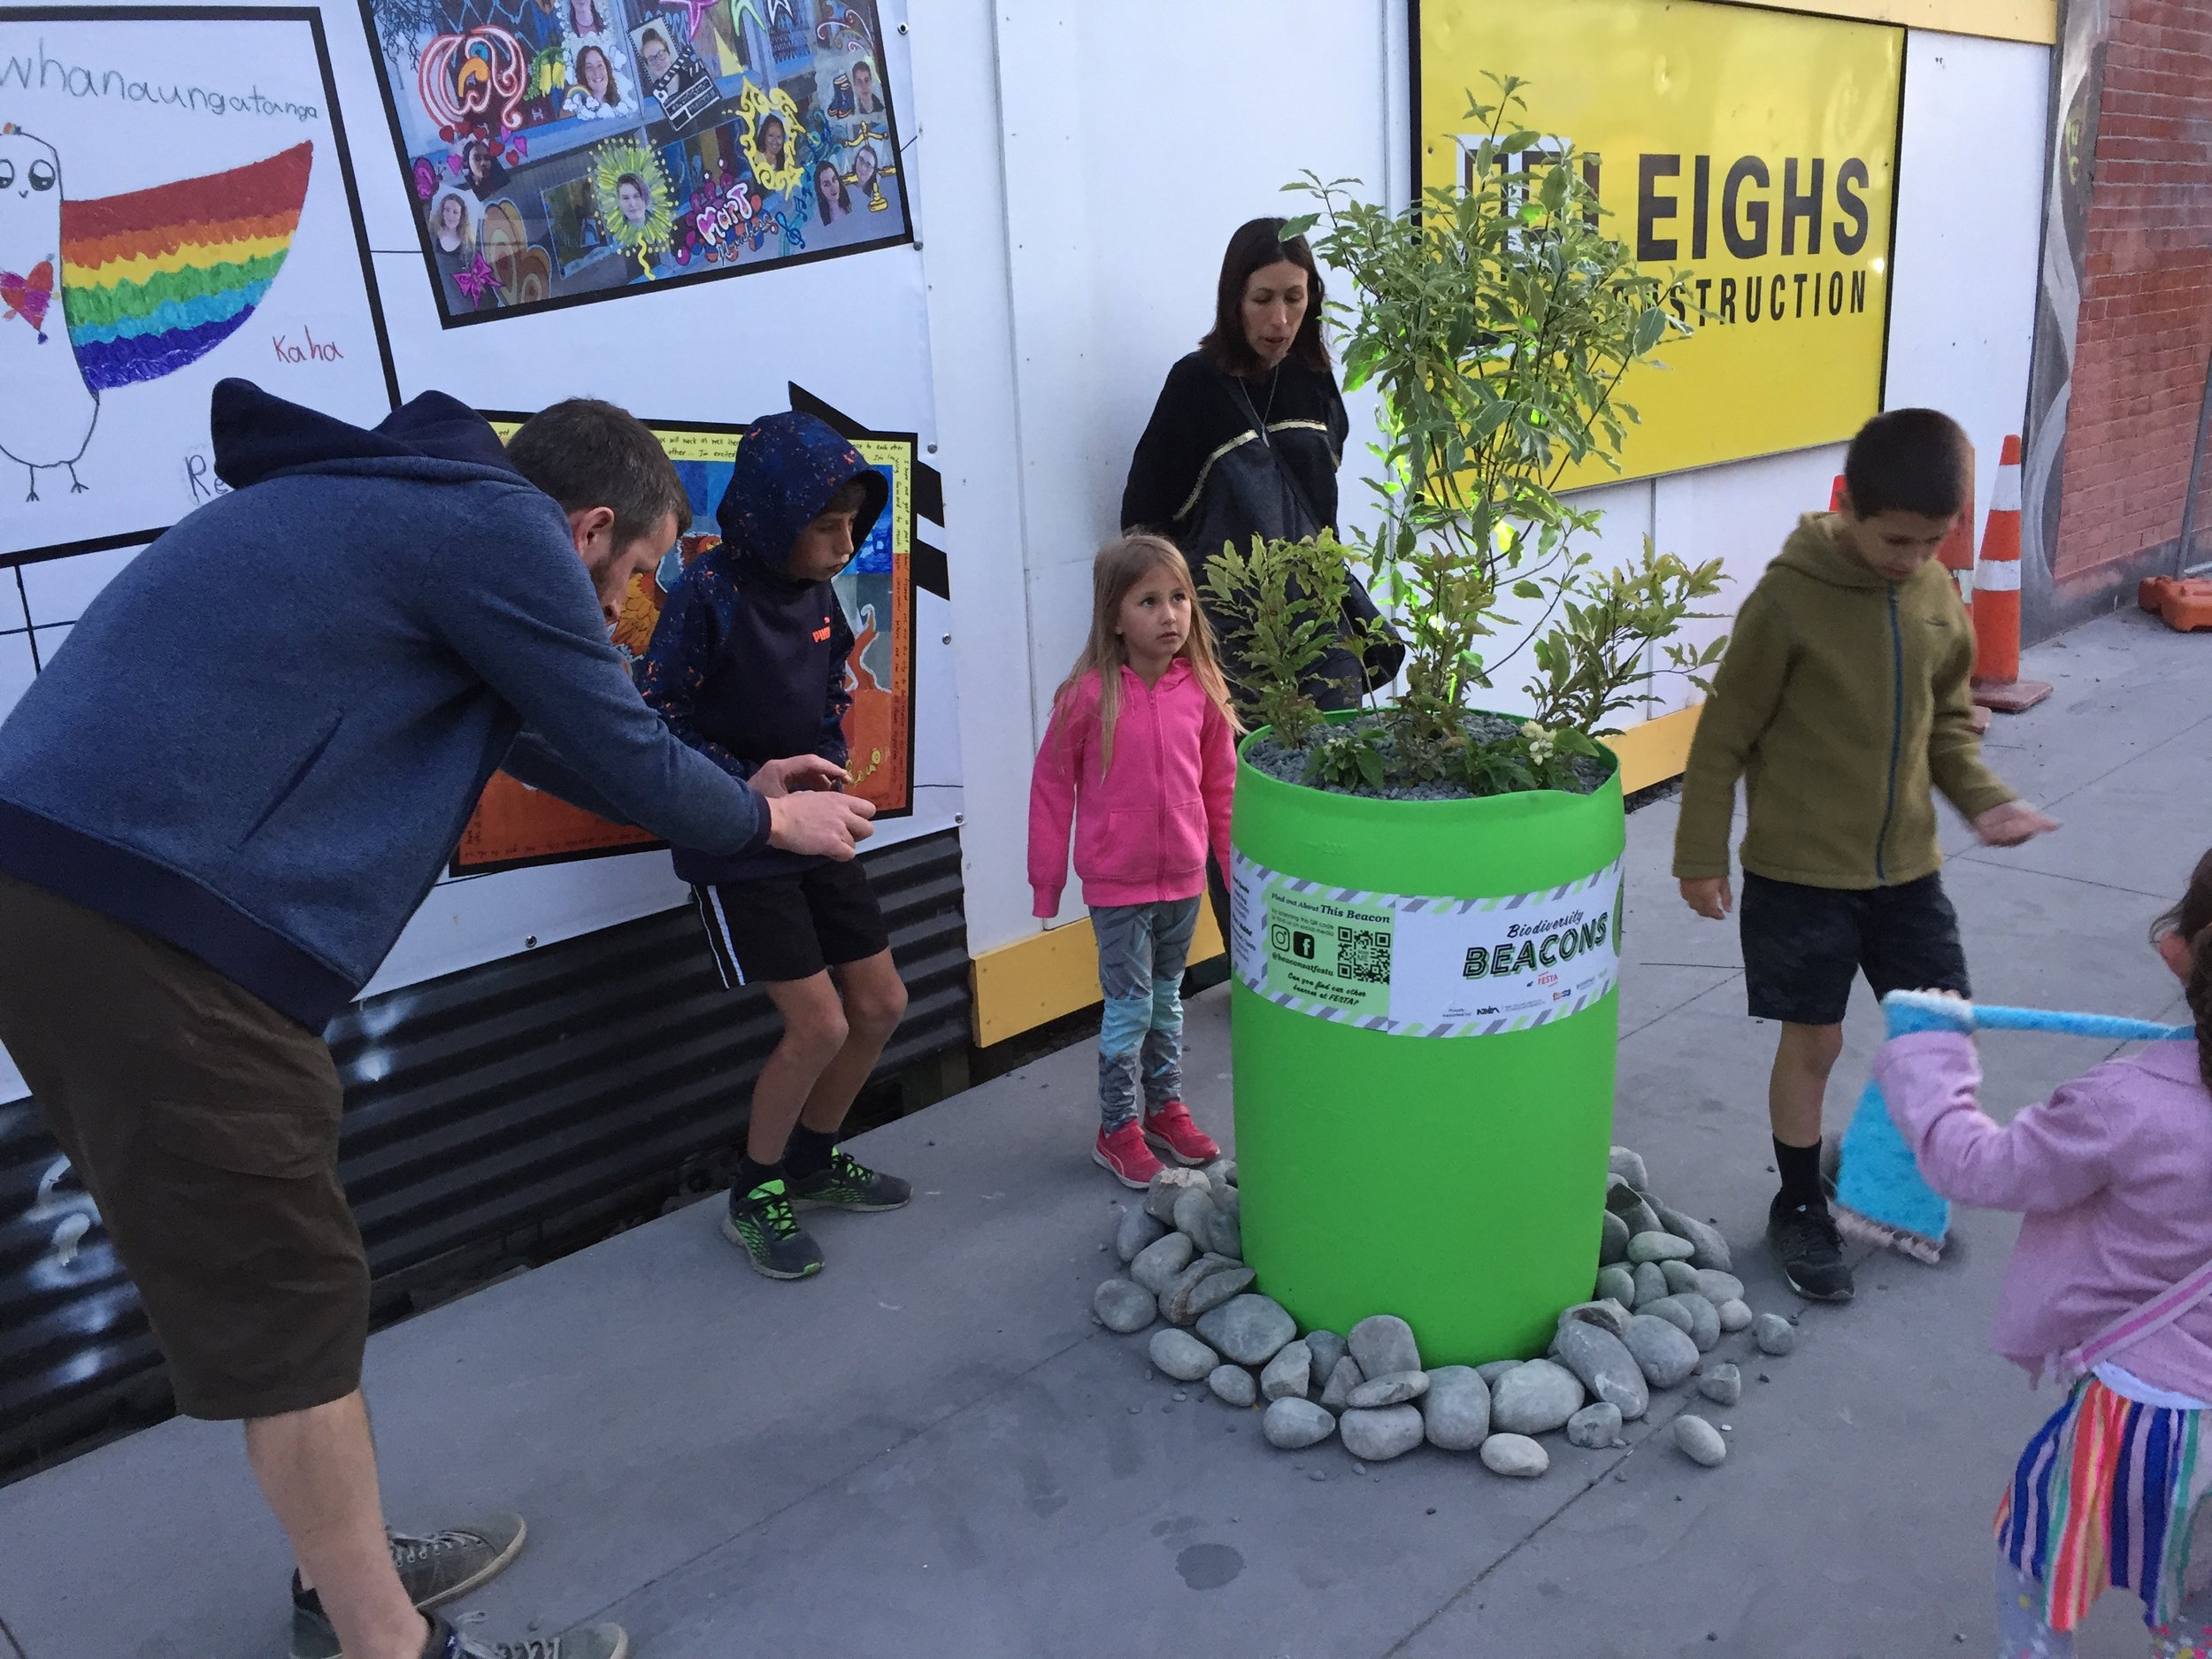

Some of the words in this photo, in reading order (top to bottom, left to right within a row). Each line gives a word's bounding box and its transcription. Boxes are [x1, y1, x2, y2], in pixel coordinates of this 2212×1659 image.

[1582, 151, 1870, 263] LEIGHS
[1593, 270, 1866, 330] STRUCTION
[1271, 893, 1285, 902] Find
[1286, 897, 1297, 907] out
[1298, 902, 1319, 912] About
[1320, 904, 1344, 918] This
[1347, 910, 1390, 924] Beacon
[1507, 910, 1584, 939] Biodiversity
[1463, 911, 1609, 979] BEACONS
[1287, 972, 1300, 982] Can
[1302, 977, 1314, 986] you
[1538, 973, 1558, 986] FESTA
[1328, 994, 1359, 1006] FESTA?
